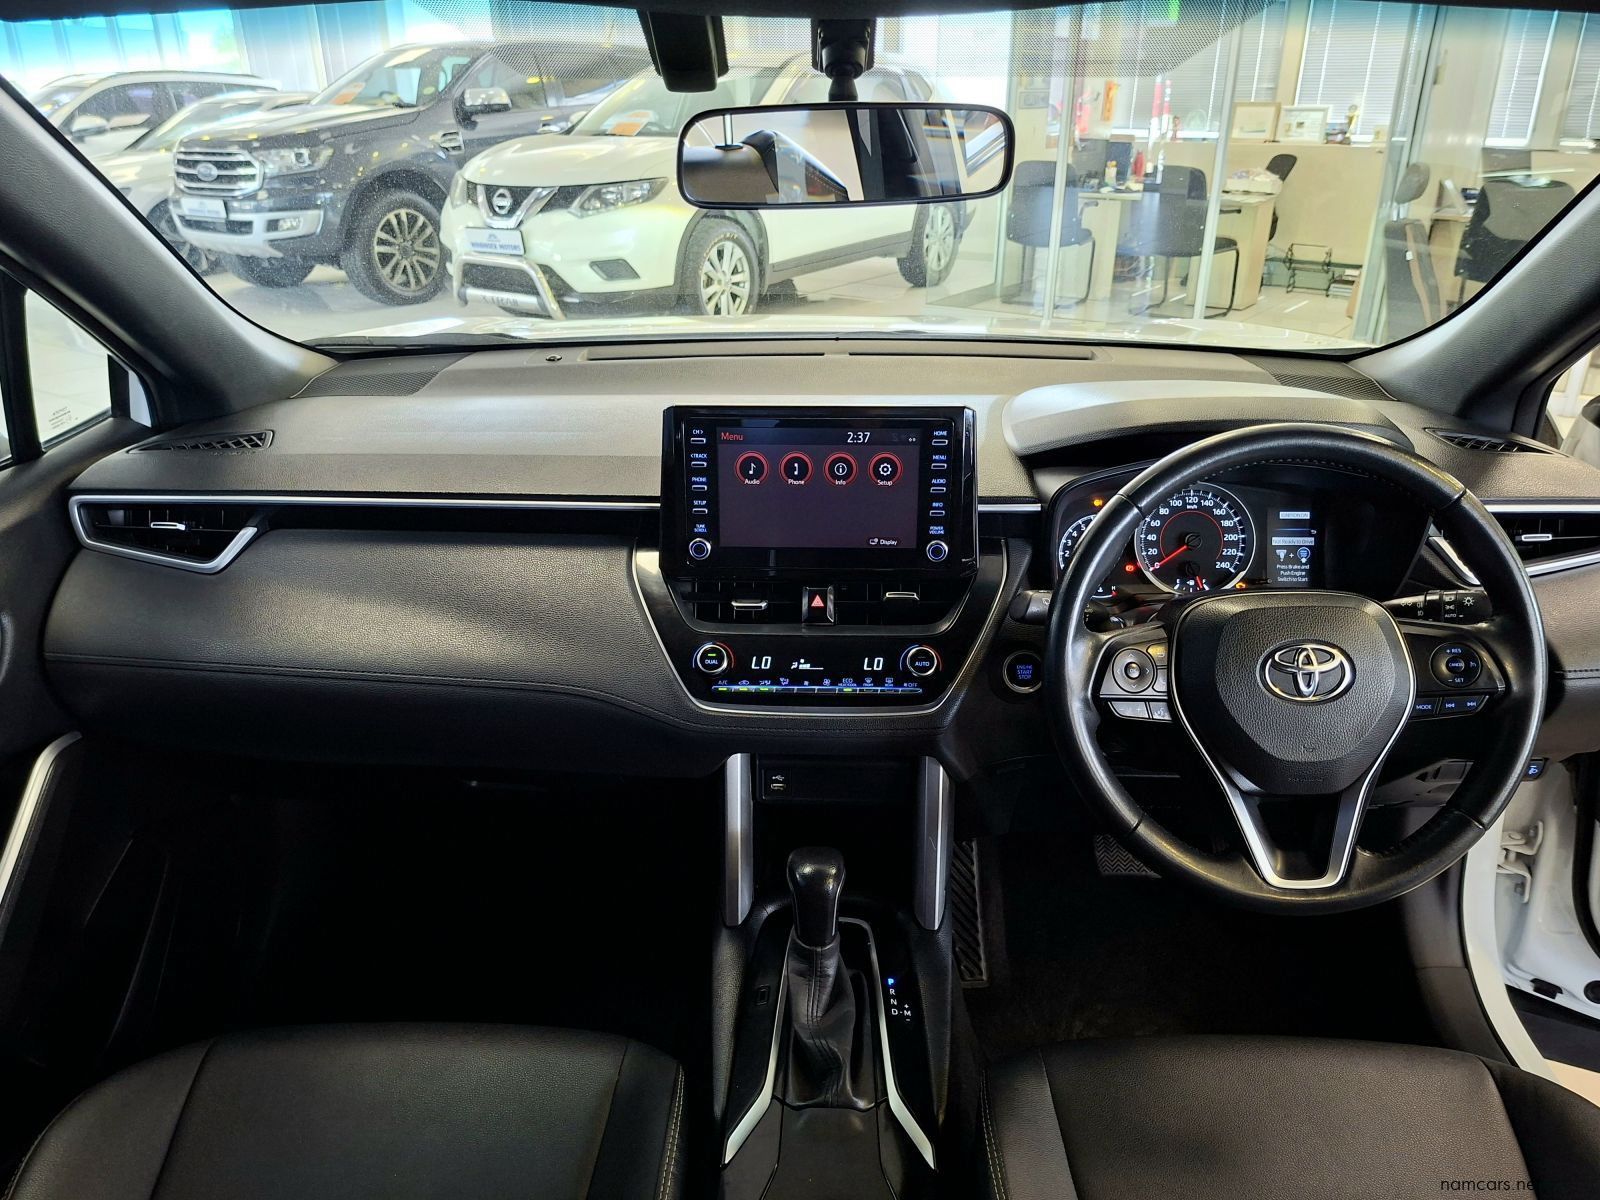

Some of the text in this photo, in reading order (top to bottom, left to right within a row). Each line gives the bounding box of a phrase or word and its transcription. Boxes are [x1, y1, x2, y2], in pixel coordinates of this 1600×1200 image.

[721, 432, 744, 440] Menu
[847, 432, 870, 444] 2:37
[752, 656, 772, 669] LO
[863, 657, 884, 670] LO
